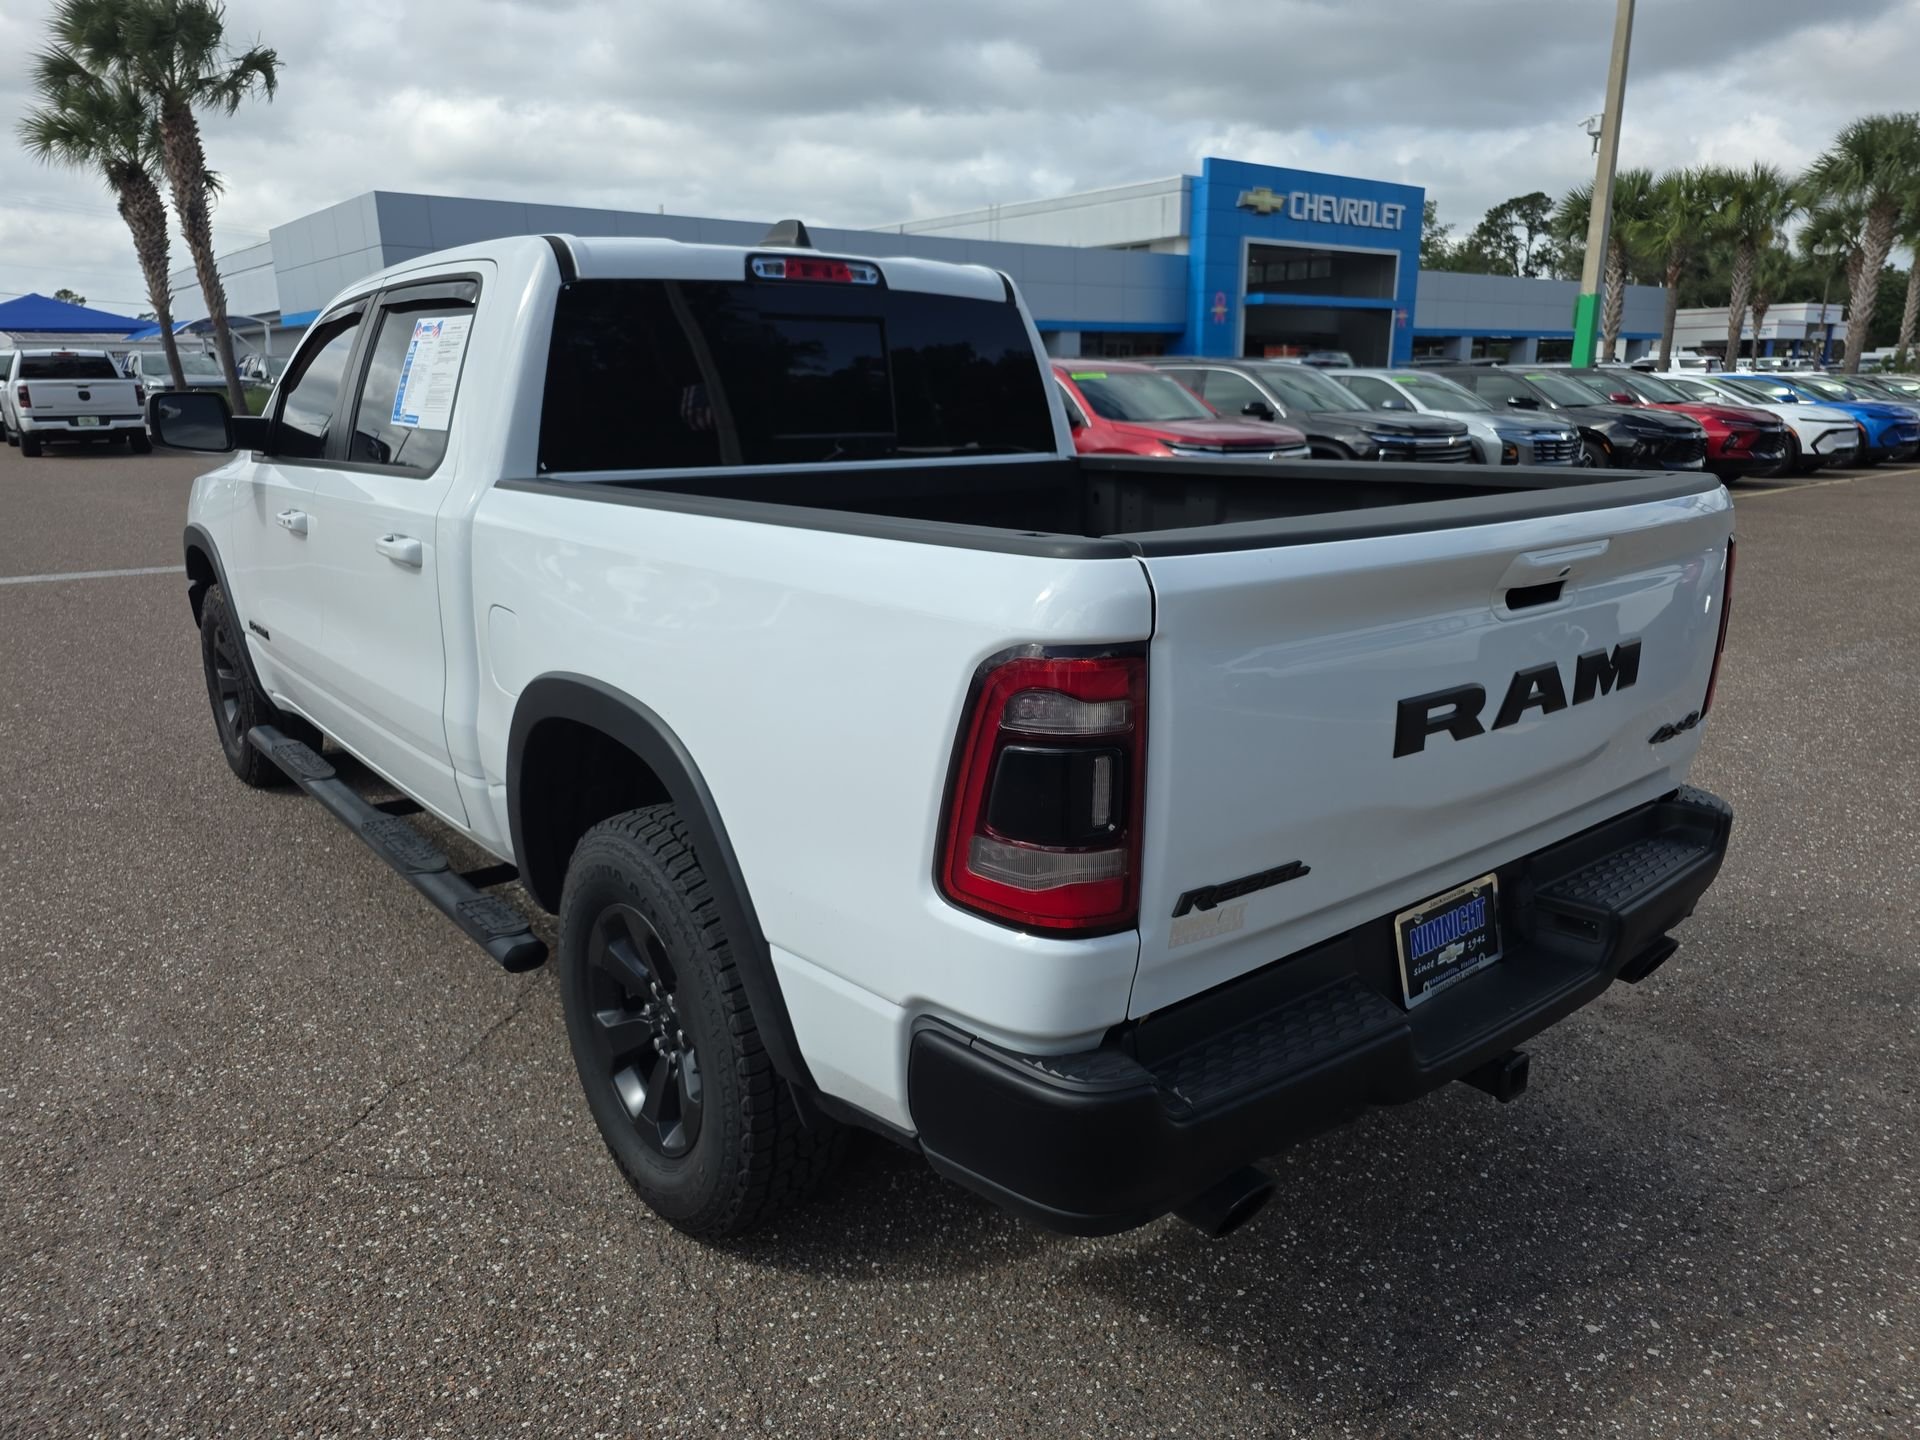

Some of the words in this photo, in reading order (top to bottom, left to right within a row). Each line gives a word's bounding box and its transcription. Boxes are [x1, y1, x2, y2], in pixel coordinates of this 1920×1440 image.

[1288, 191, 1406, 230] CHEVROLET
[1393, 637, 1641, 758] RAM
[1171, 860, 1311, 918] REBEL
[1410, 896, 1485, 960] NIMNICHT
[1413, 960, 1435, 976] since
[1467, 934, 1486, 951] 1941
